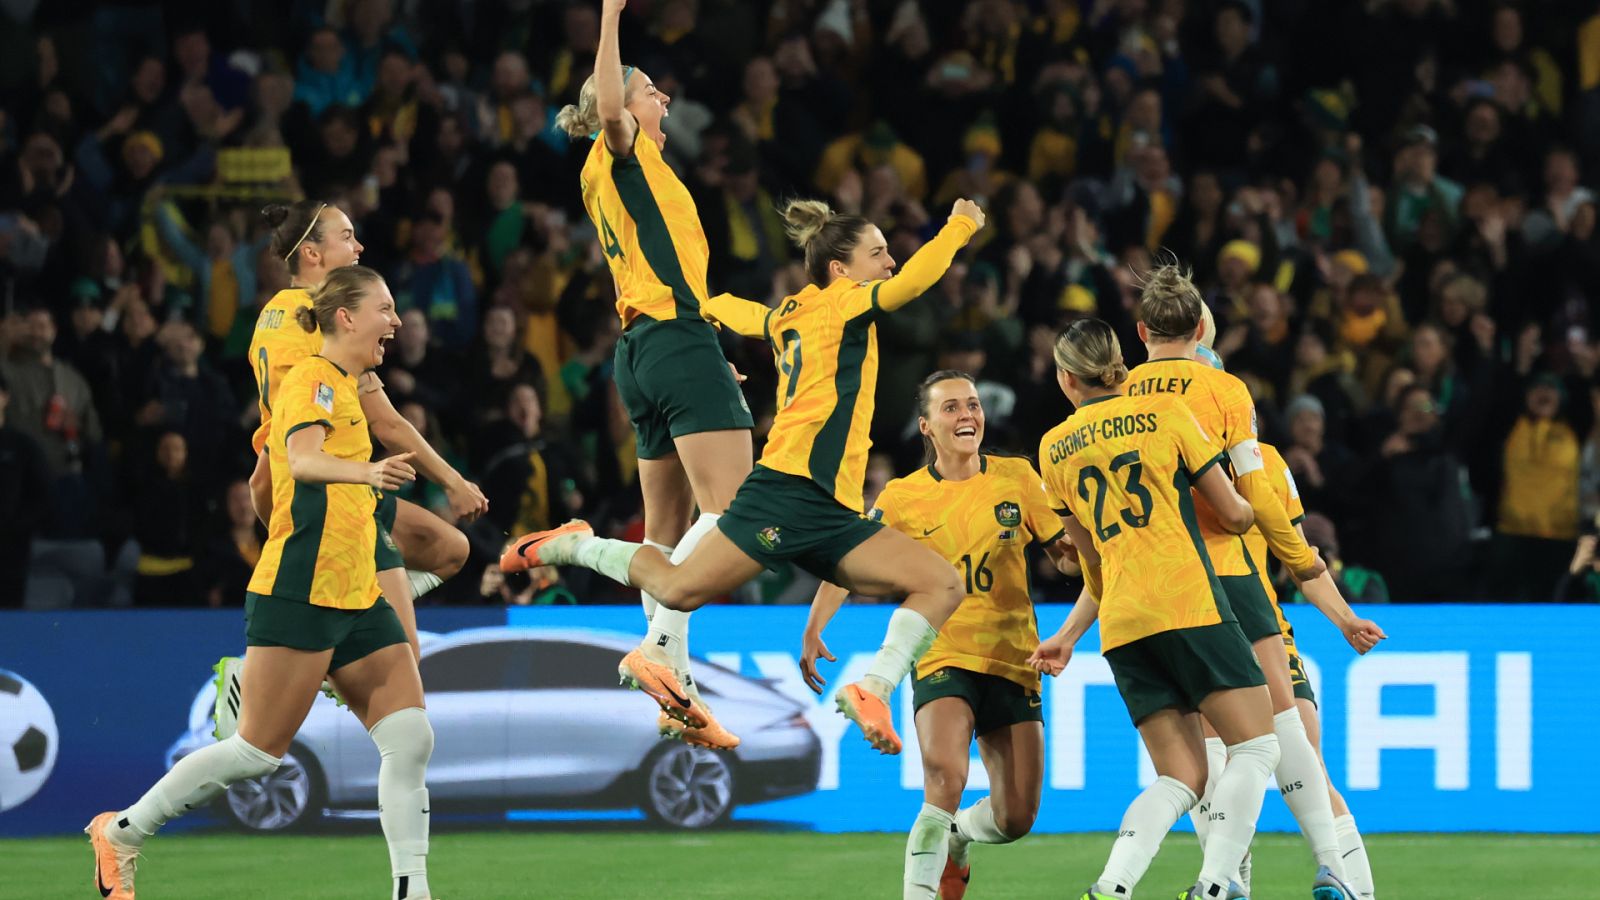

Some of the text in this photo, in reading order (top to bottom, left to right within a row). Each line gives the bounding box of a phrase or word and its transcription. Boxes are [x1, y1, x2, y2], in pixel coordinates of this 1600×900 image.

[771, 328, 802, 408] 9
[1128, 377, 1192, 397] CATLEY
[1049, 413, 1158, 465] COONEY-CROSS
[1077, 449, 1153, 543] 23
[961, 551, 994, 594] 16
[1280, 780, 1303, 797] AUS
[1118, 830, 1136, 838] US
